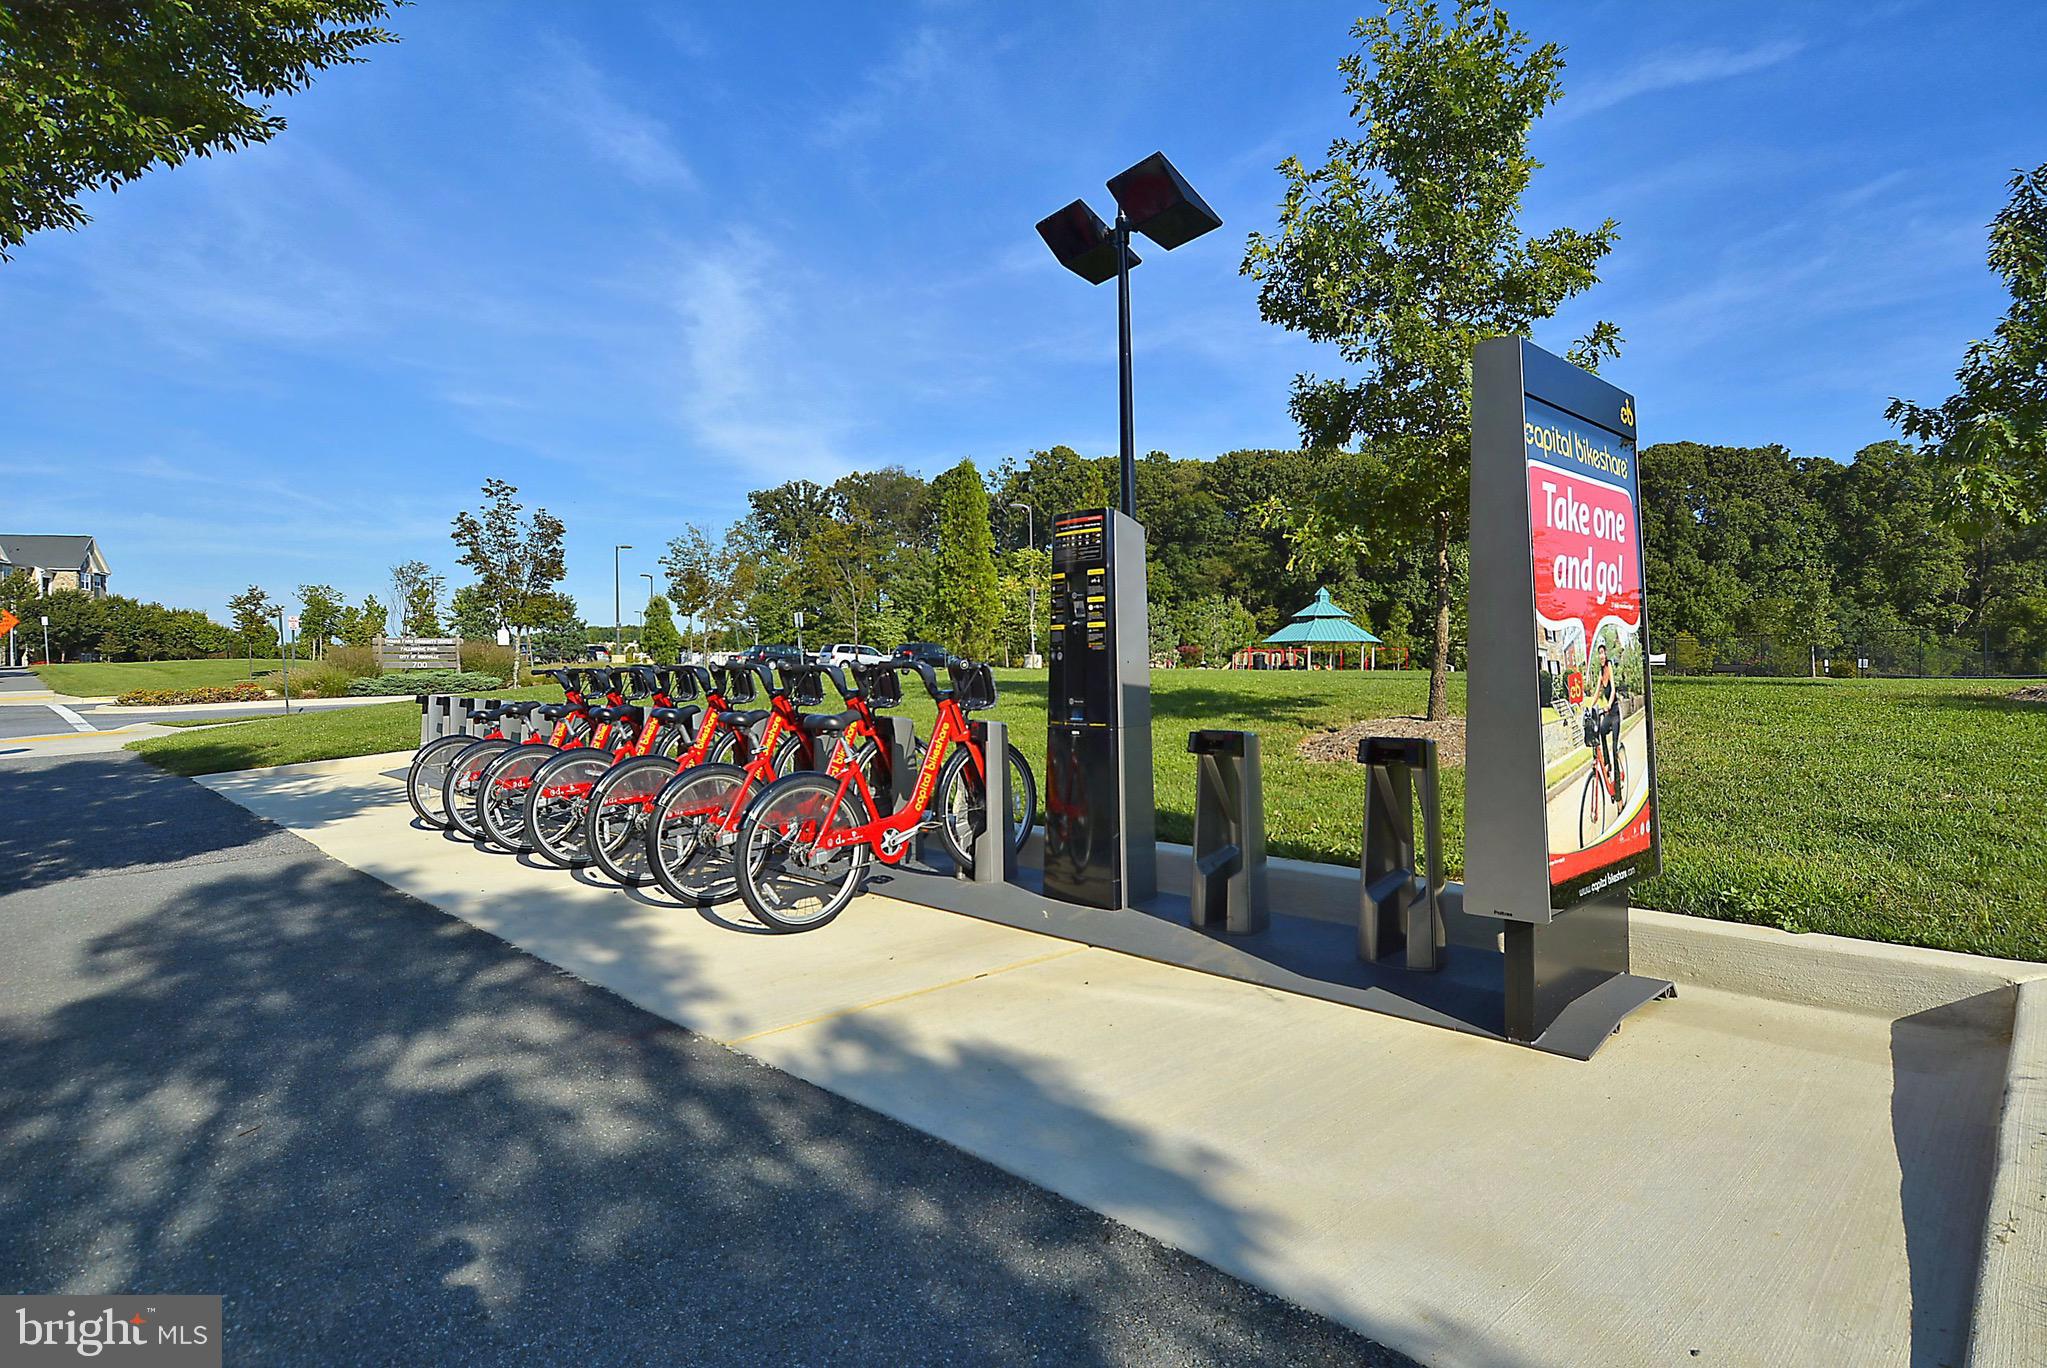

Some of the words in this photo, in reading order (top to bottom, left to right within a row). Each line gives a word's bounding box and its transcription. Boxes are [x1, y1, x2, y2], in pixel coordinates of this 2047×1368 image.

[1525, 422, 1573, 459] capital
[1574, 432, 1628, 480] bikeshare
[1542, 480, 1590, 536] Take
[1593, 506, 1626, 544] one
[1553, 546, 1593, 592] and
[1595, 554, 1623, 605] go!
[412, 661, 428, 669] 700
[915, 772, 933, 812] capital
[925, 722, 950, 771] bikeshare
